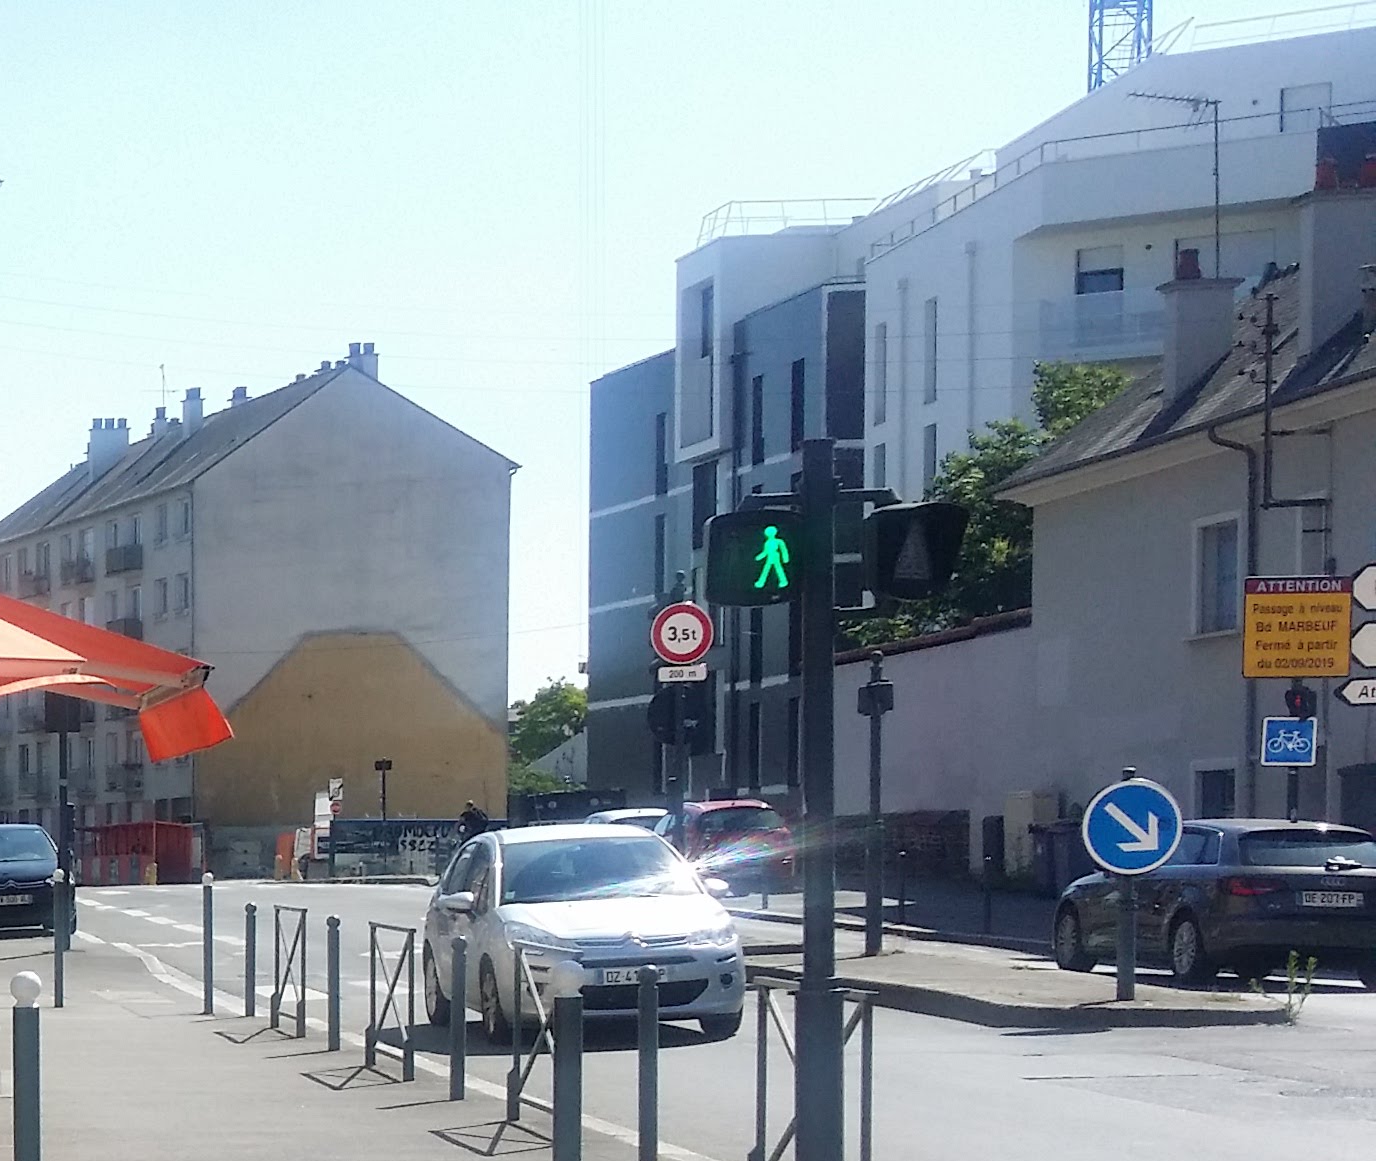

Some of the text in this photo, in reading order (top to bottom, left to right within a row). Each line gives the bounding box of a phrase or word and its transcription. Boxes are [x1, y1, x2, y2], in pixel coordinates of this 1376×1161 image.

[1257, 580, 1342, 592] ATTENTION
[1252, 604, 1343, 616] Passage à niveau
[1256, 621, 1338, 632] Bd MARBEUF
[1255, 640, 1338, 652] Fermé à partir
[1257, 658, 1272, 668] du
[668, 670, 684, 678] 200
